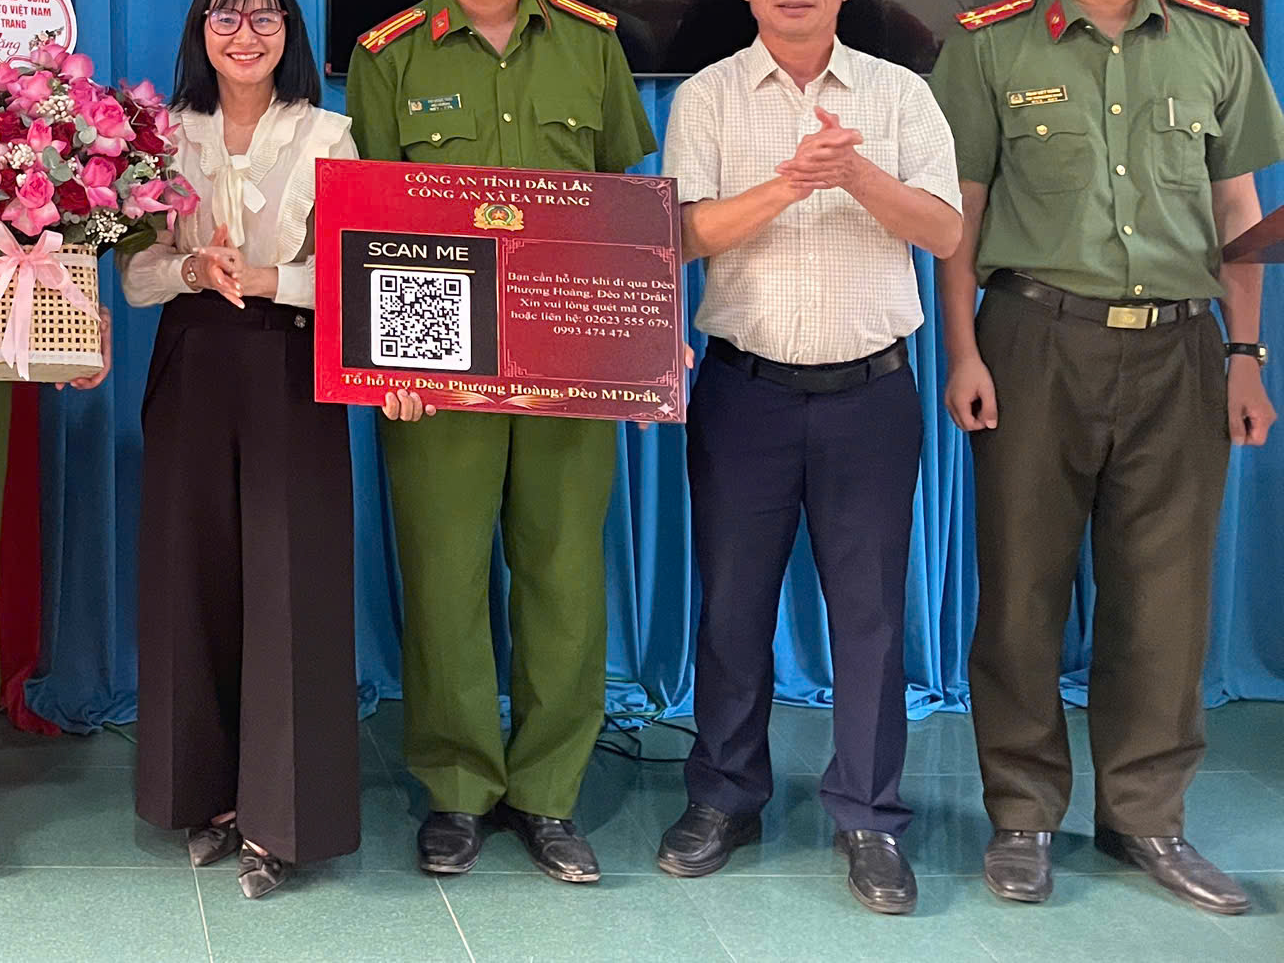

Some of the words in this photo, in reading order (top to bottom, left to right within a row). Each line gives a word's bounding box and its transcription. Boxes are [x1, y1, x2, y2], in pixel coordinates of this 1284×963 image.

[10, 4, 28, 17] VIỆT
[30, 7, 52, 17] NAM
[1, 19, 26, 29] TRANG
[405, 172, 450, 184] CÔNG
[456, 177, 476, 185] AN
[480, 175, 520, 188] TỈNH
[408, 187, 454, 198] CÔNG
[460, 191, 480, 201] AN
[486, 190, 506, 202] XÃ
[511, 193, 531, 203] EA
[535, 195, 590, 207] TRANG
[368, 241, 428, 260] SCAN
[437, 245, 469, 261] ME
[508, 272, 530, 282] Bạn
[574, 277, 589, 285] trợ
[592, 277, 610, 285] khi
[613, 278, 624, 286] đi
[628, 281, 648, 289] qua
[506, 285, 550, 296] Phượng
[520, 298, 540, 308] Xin
[544, 300, 561, 309] vui
[566, 300, 590, 312] lòng
[620, 304, 637, 313] mã
[640, 305, 660, 315] QR
[510, 311, 538, 320] hoặc
[541, 312, 562, 321] liên
[566, 314, 582, 323] hệ:
[585, 315, 620, 325] 02623
[624, 316, 644, 326] 555
[553, 326, 582, 335] 0993
[584, 327, 606, 337] 474
[609, 329, 631, 338] 474
[366, 374, 385, 386] hỗ
[388, 377, 412, 389] trợ
[416, 378, 444, 390] Đèo
[448, 381, 506, 395] Phượng
[510, 383, 564, 398] Hoàng,
[568, 387, 598, 399] Đèo
